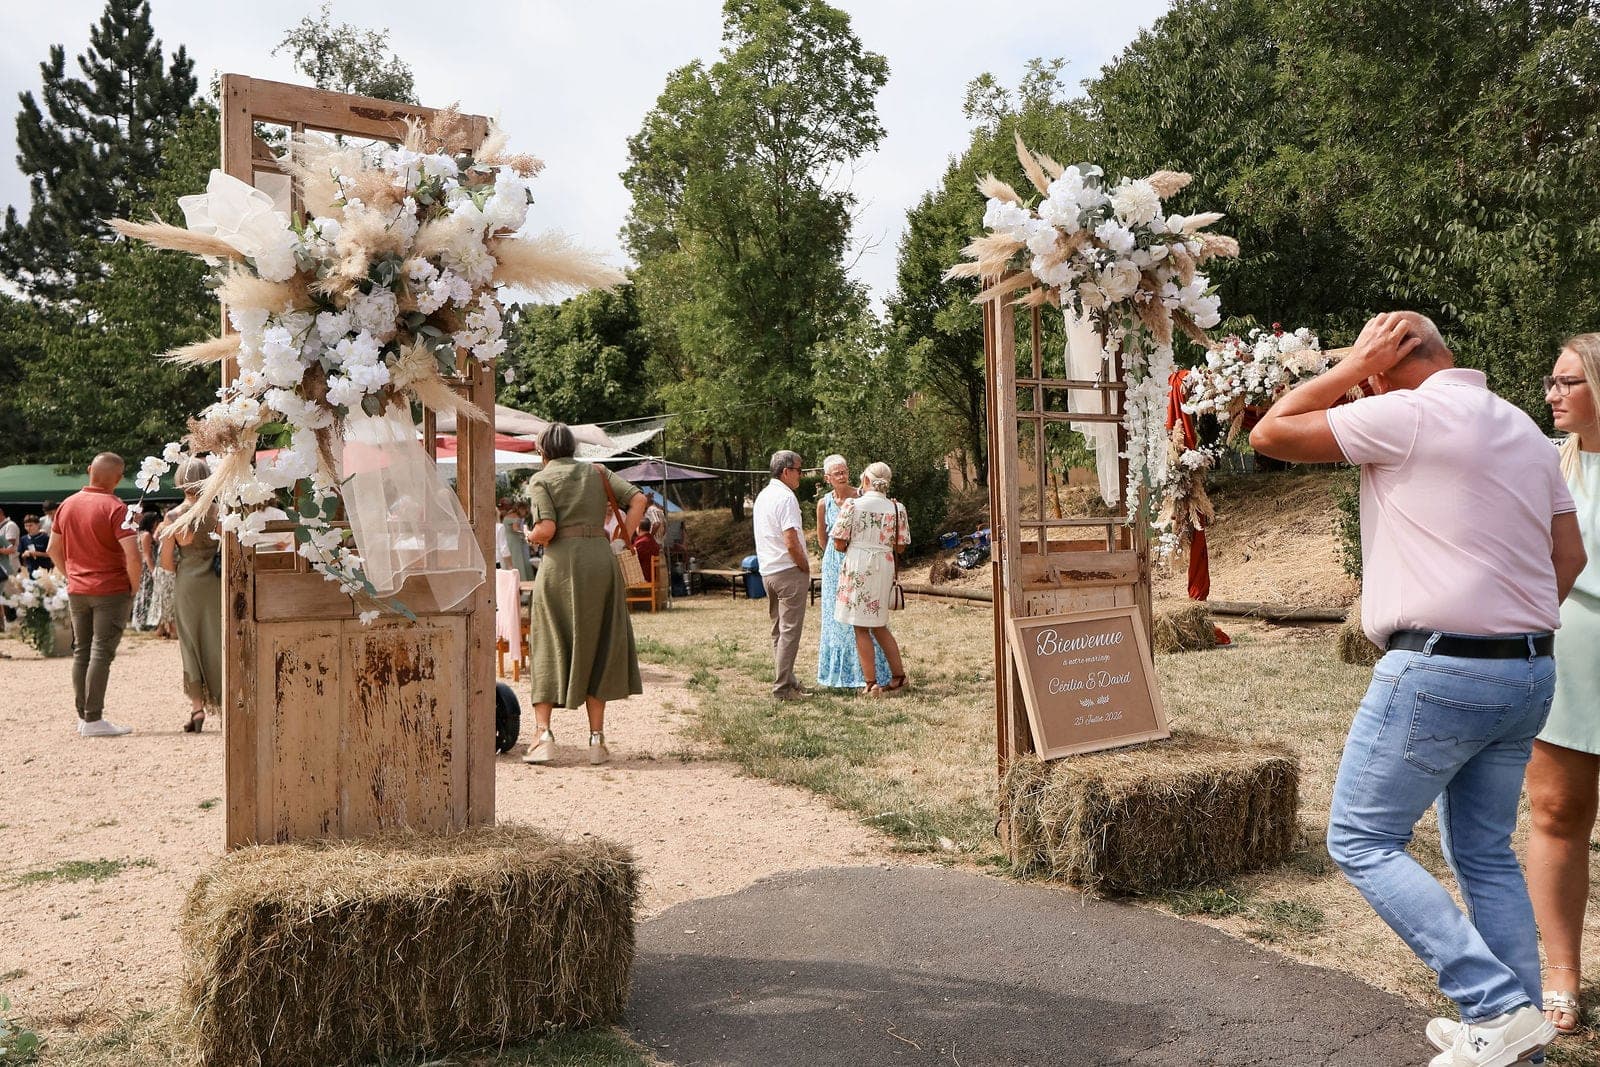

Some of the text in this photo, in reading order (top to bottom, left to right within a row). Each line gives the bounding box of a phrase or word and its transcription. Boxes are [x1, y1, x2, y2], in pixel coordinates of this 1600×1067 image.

[1037, 629, 1123, 656] Bienvenue
[1086, 672, 1096, 690] &
[1097, 671, 1131, 688] David
